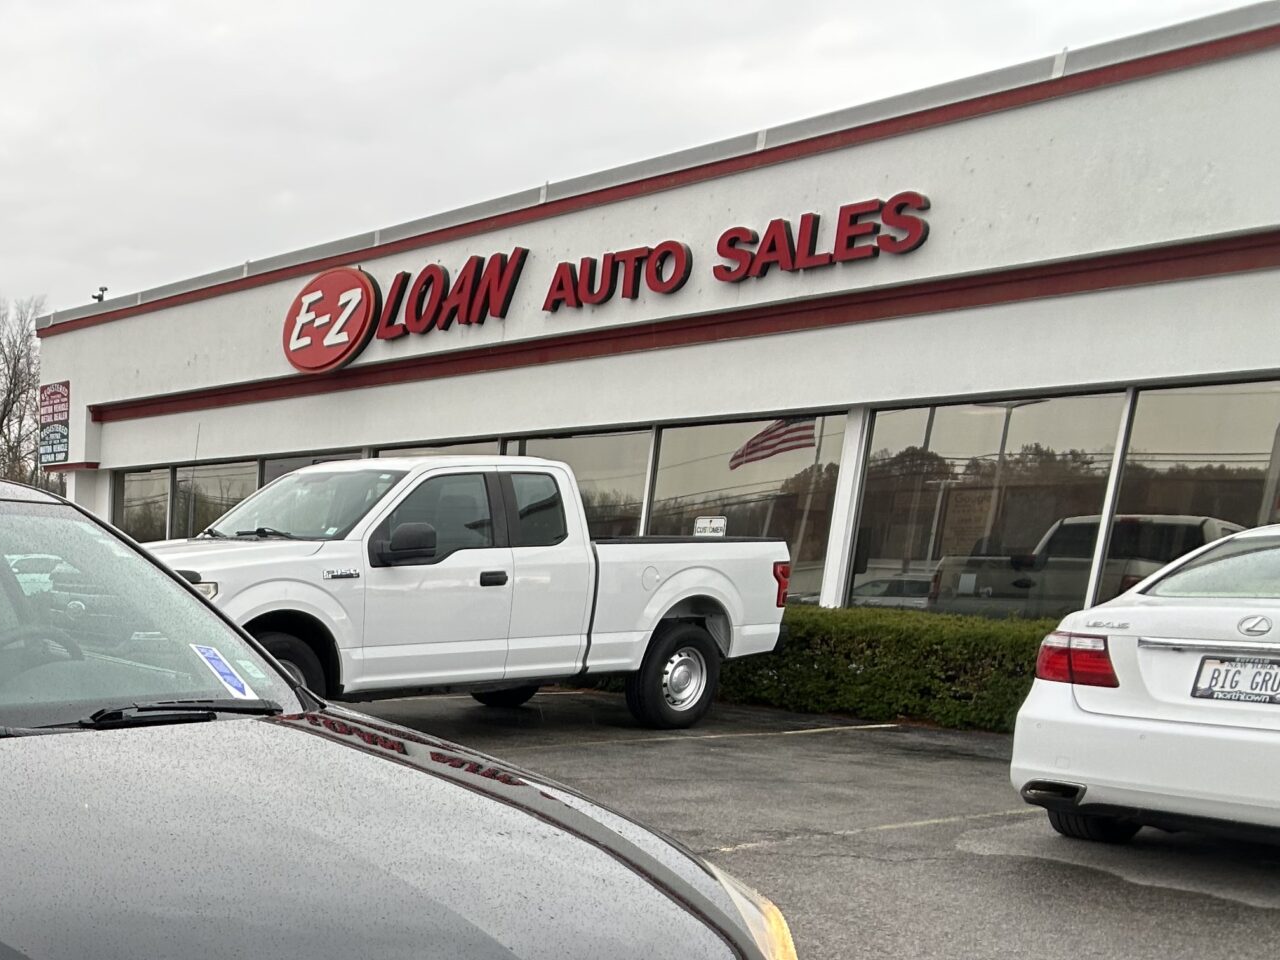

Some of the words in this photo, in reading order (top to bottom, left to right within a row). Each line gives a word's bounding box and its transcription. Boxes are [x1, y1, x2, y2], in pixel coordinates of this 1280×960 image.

[289, 287, 362, 351] E-Z
[376, 246, 530, 341] LOAN
[542, 239, 693, 312] AUTO
[712, 190, 931, 284] SALES
[696, 526, 724, 534] CUSTOMER
[1086, 621, 1130, 629] LEXUS
[1251, 663, 1276, 671] YORK
[1209, 668, 1241, 690] BIG
[1250, 670, 1280, 693] GRU
[1214, 690, 1270, 703] northtown
